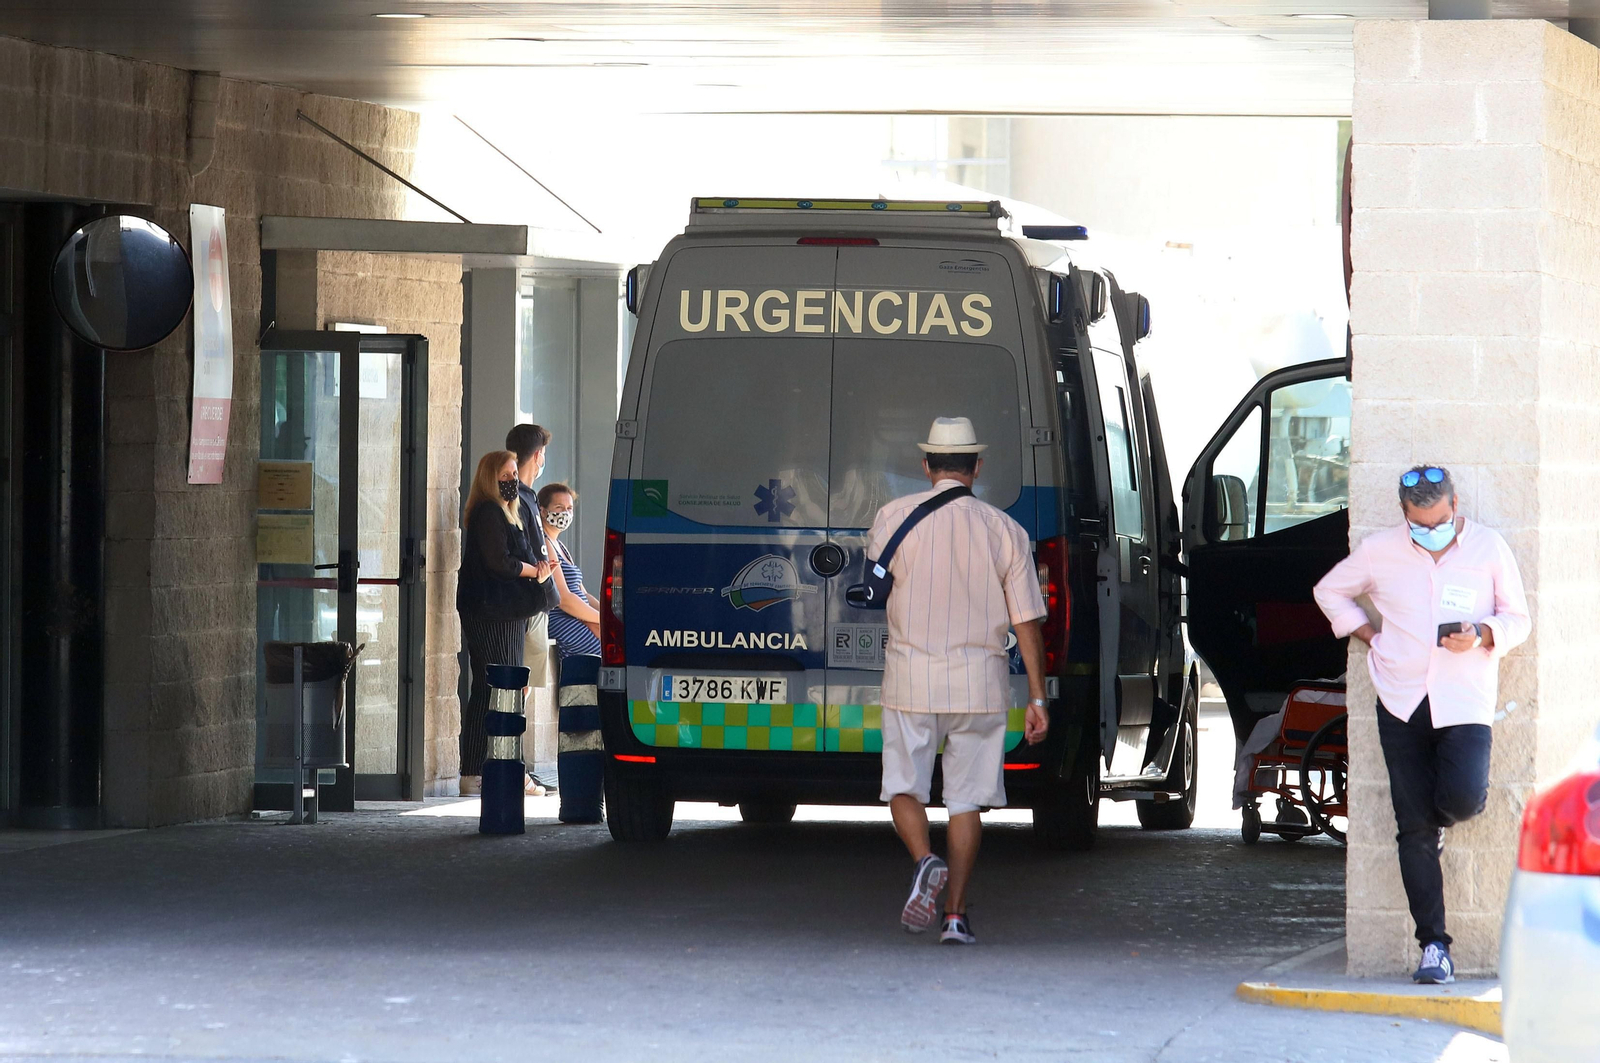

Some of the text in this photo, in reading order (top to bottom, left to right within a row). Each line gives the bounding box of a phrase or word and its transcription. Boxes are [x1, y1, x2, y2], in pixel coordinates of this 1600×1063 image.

[679, 289, 993, 337] URGENCIAS
[636, 586, 715, 594] SPRINTER
[645, 629, 808, 650] AMBULANCIA
[678, 679, 782, 701] 3786 KWF
